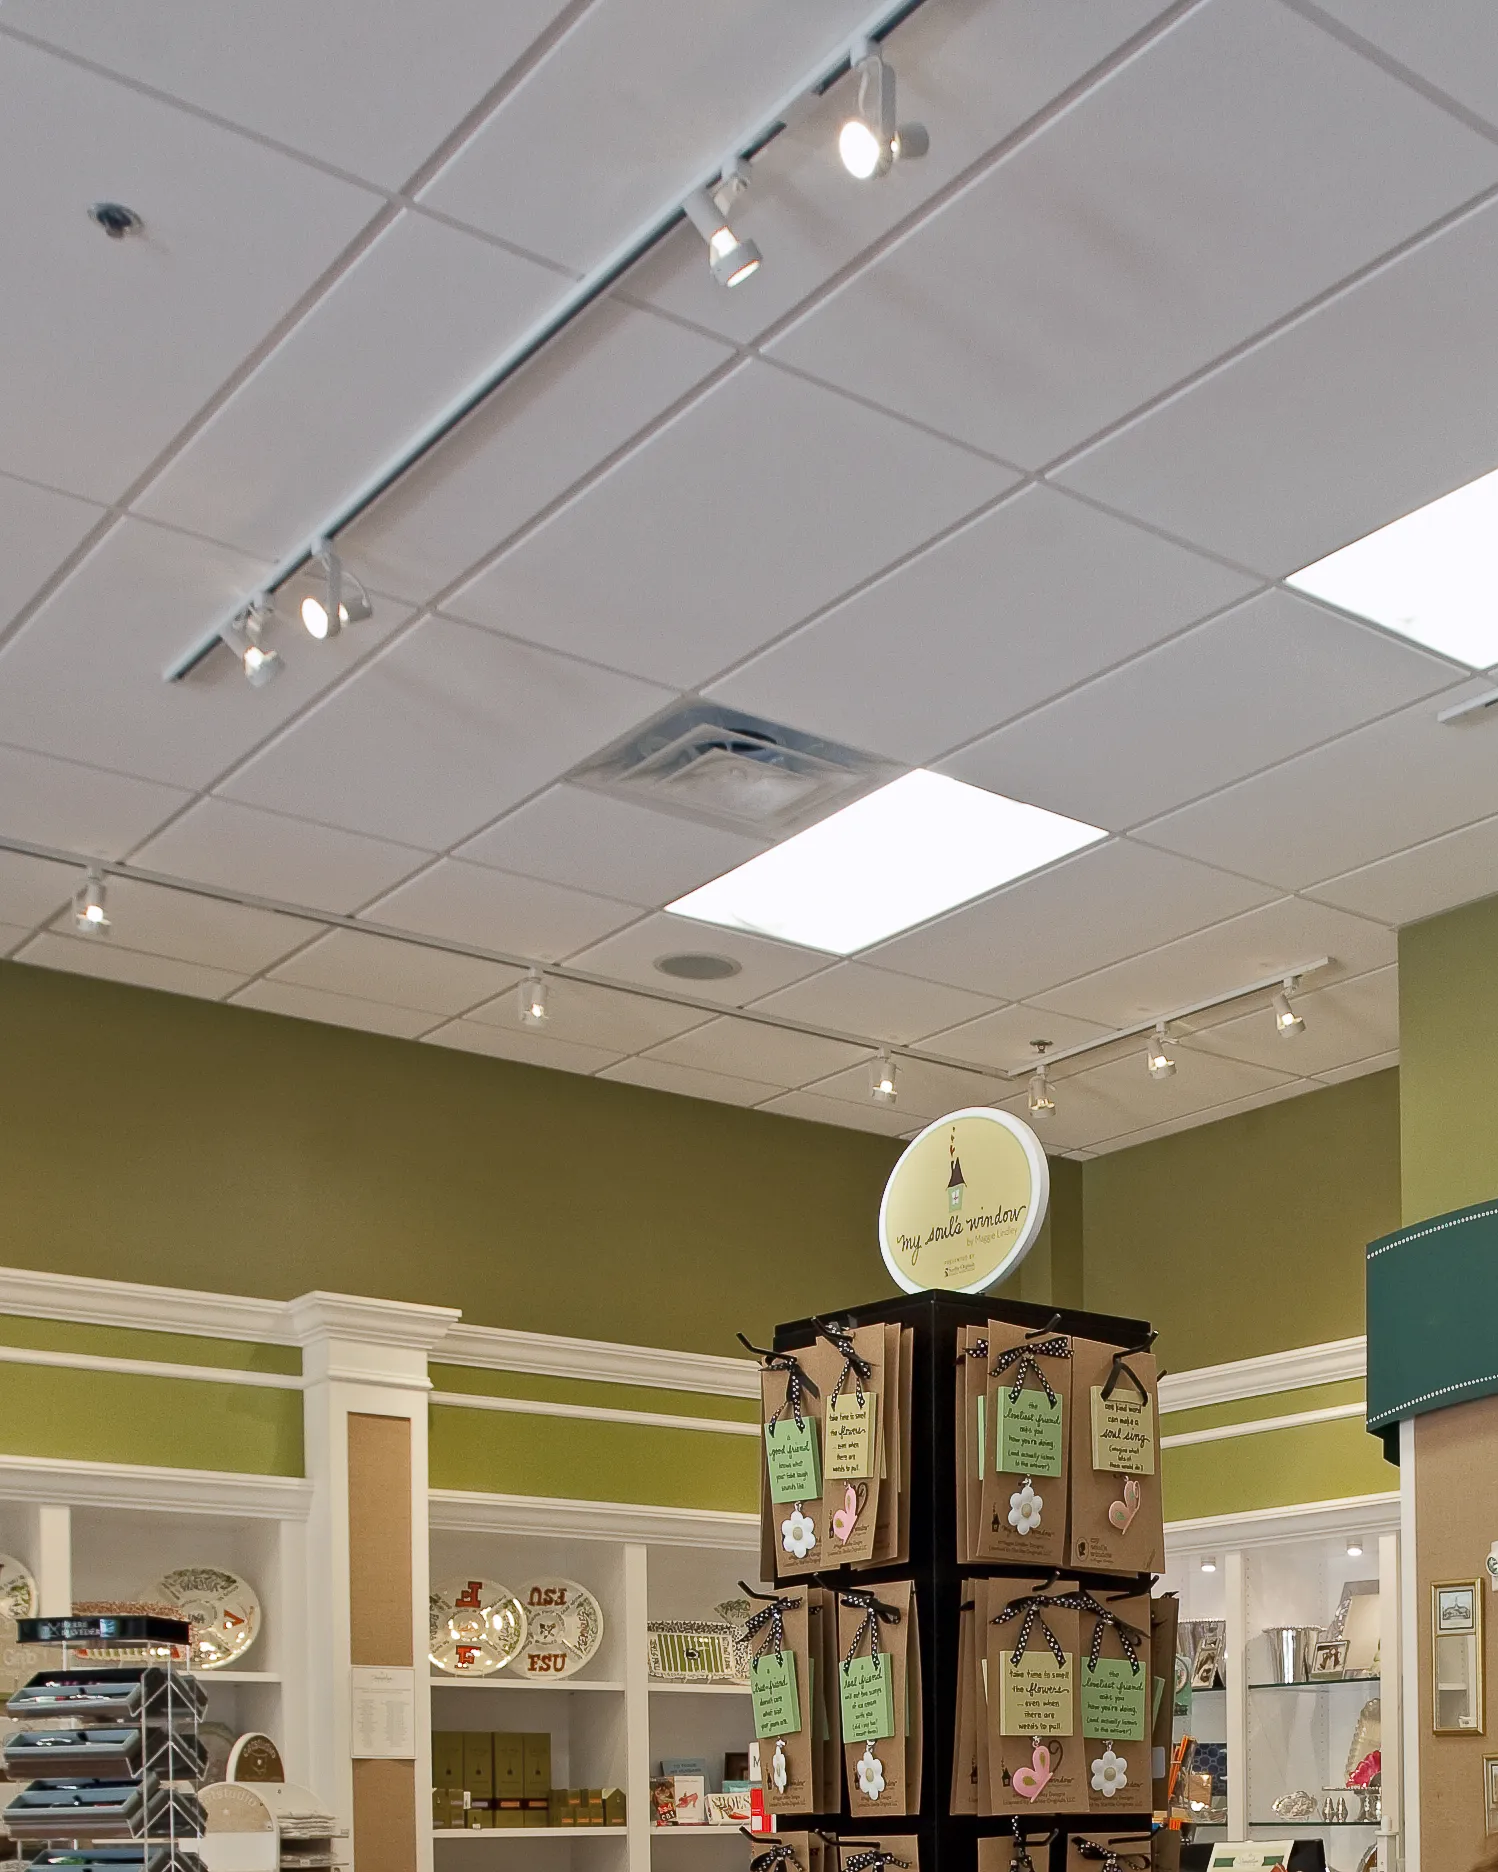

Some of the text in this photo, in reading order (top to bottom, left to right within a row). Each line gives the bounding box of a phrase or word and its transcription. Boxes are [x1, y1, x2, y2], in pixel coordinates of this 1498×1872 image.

[896, 1205, 1026, 1266] my soul's window
[974, 1233, 996, 1245] Maggie
[1036, 1414, 1060, 1427] friend
[1100, 1428, 1150, 1448] soul sing
[787, 1441, 810, 1459] friend
[528, 1587, 568, 1606] FSU
[528, 1653, 567, 1672] FSU
[1026, 1683, 1070, 1697] flowers
[1116, 1682, 1144, 1694] friend
[712, 1794, 751, 1811] SHOES
